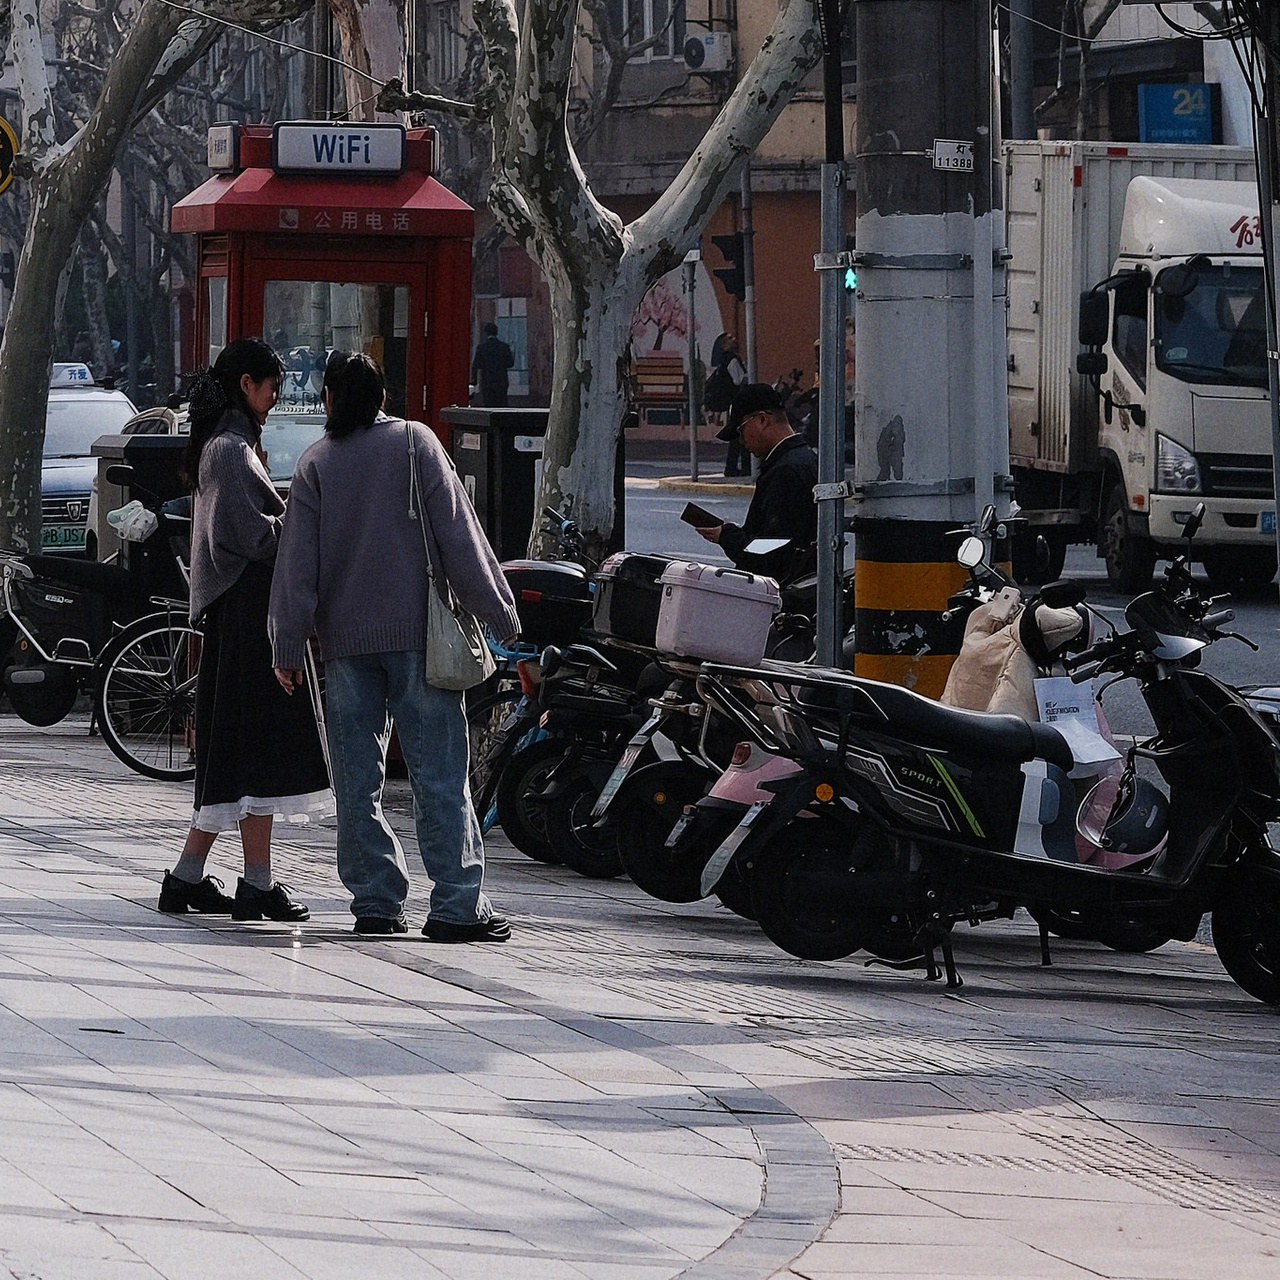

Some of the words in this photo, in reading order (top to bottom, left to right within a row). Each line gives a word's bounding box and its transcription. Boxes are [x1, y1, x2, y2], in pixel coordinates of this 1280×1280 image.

[1173, 89, 1206, 115] 24
[313, 133, 371, 164] WiFi
[314, 211, 411, 231] 公用电话
[901, 766, 942, 788] SPORT
